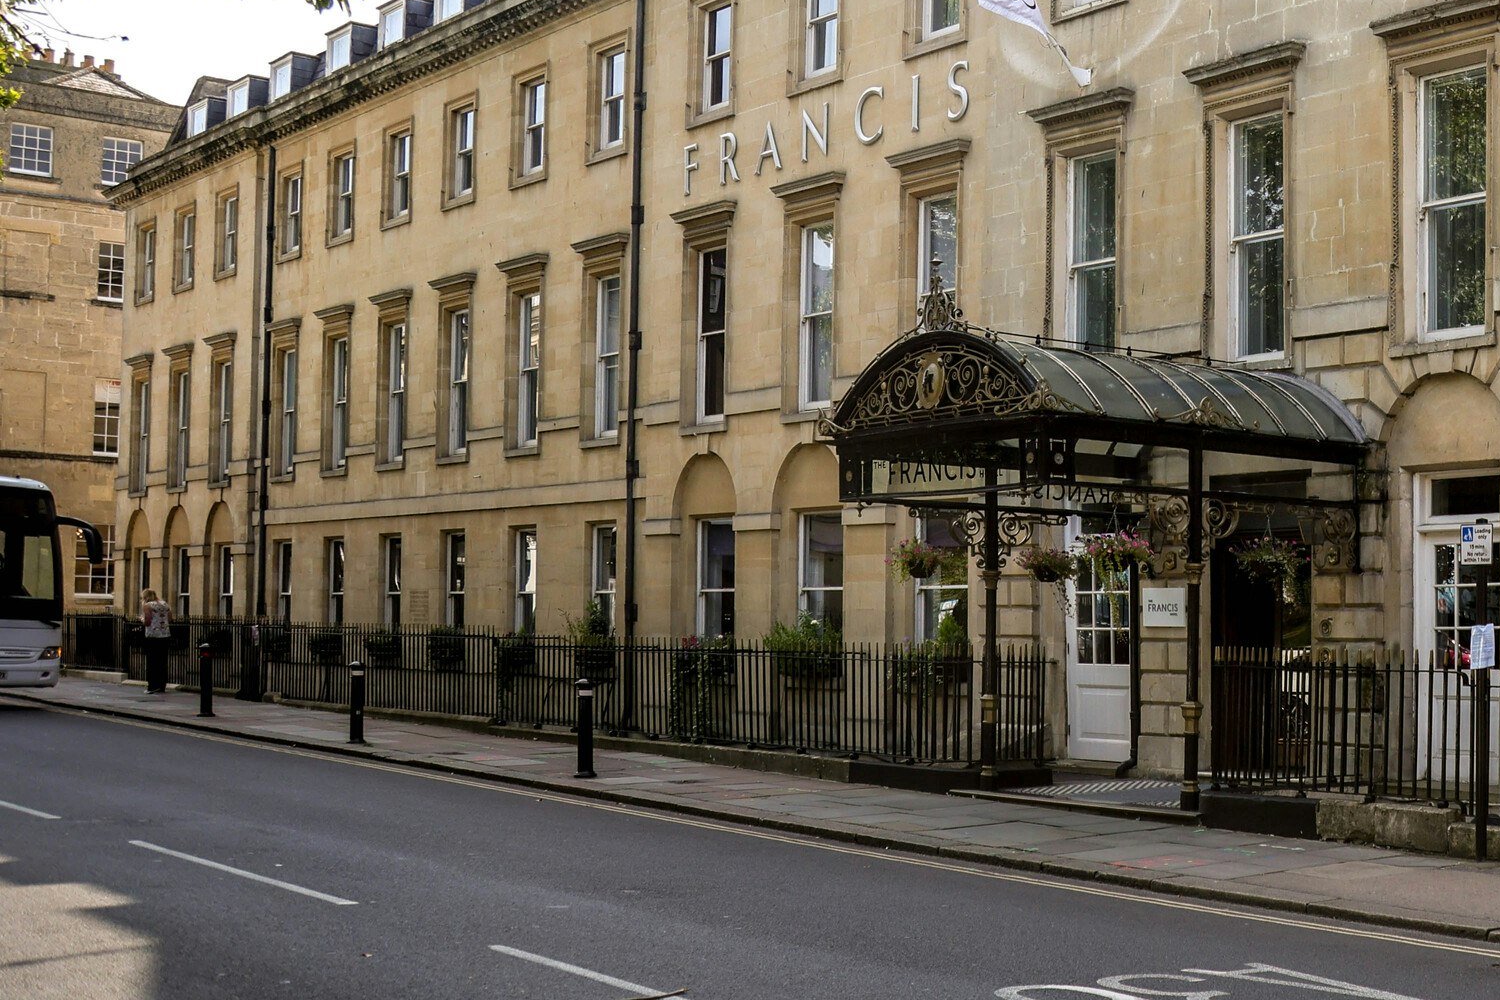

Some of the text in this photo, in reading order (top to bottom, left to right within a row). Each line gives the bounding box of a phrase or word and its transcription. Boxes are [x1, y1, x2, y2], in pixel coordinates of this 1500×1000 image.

[684, 60, 969, 196] FRANCIS
[873, 460, 887, 469] THE
[1147, 603, 1179, 612] FRANCIS
